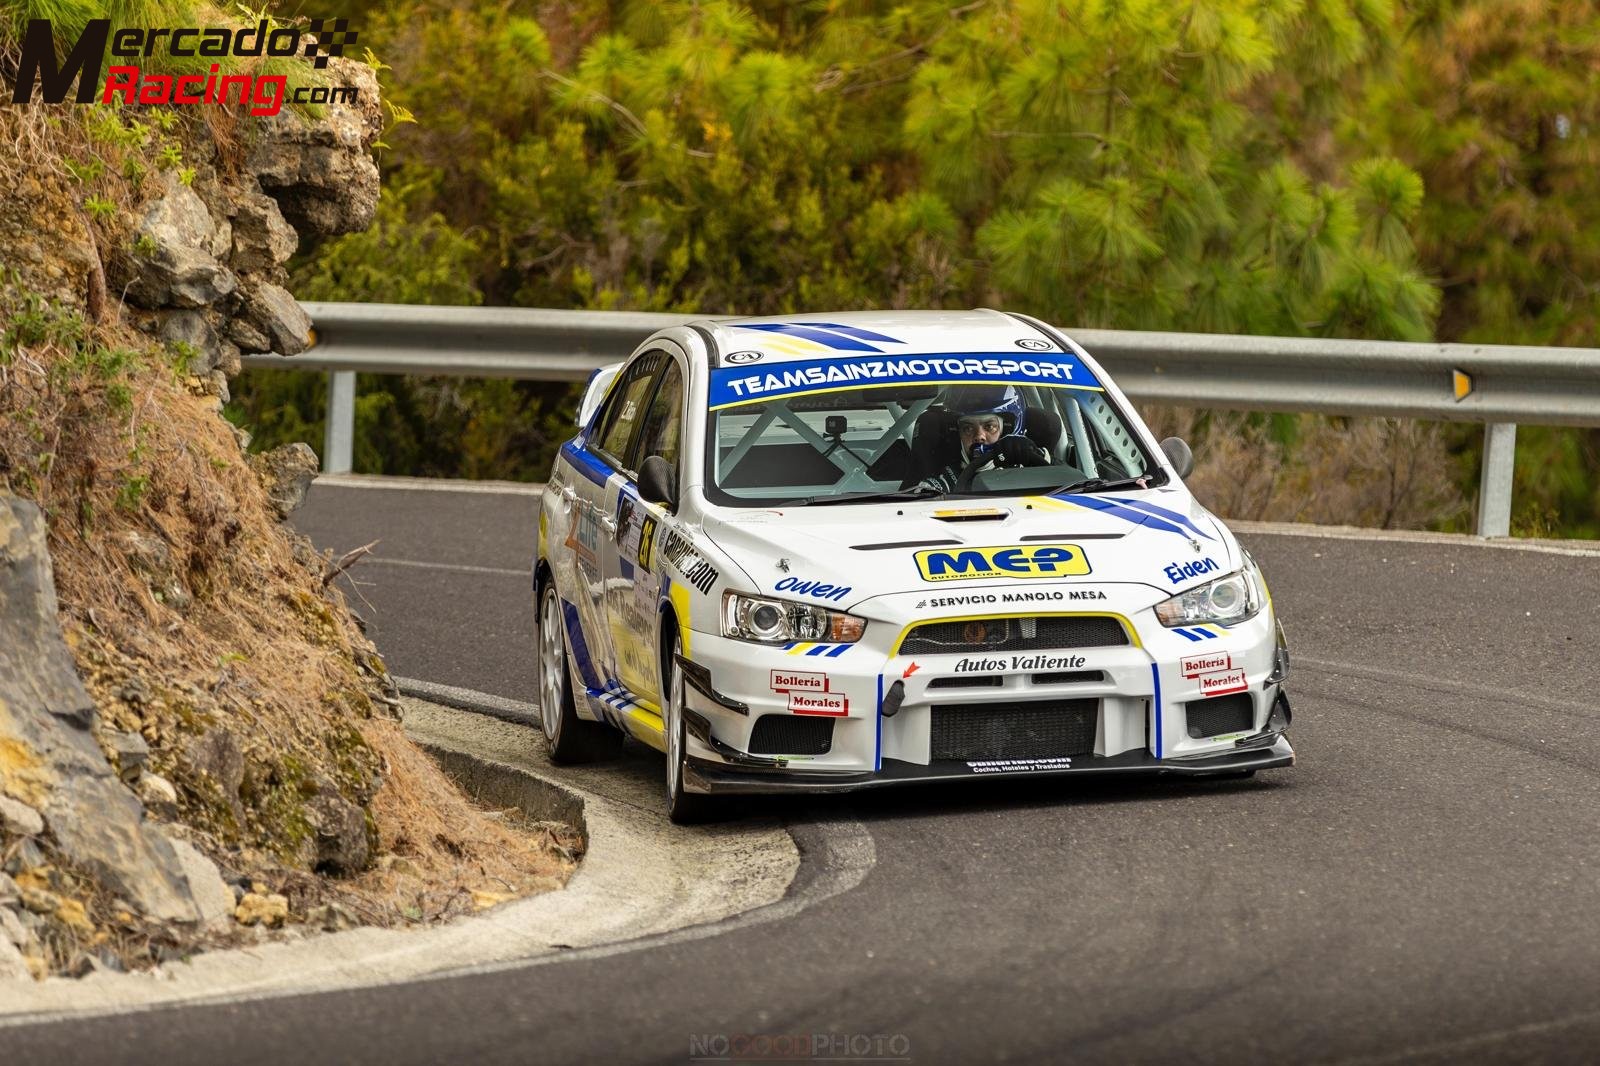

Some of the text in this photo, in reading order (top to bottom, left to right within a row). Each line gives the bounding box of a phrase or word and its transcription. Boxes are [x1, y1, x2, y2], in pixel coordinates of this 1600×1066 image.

[728, 359, 1074, 396] TEAMSAINZMOTORSPORT
[1163, 557, 1220, 584] Eiden
[930, 590, 1107, 608] SERVICIO MANOLO MESA
[954, 655, 1086, 673] Autos Valiente
[1203, 676, 1240, 688] Morales
[793, 696, 841, 708] Morales
